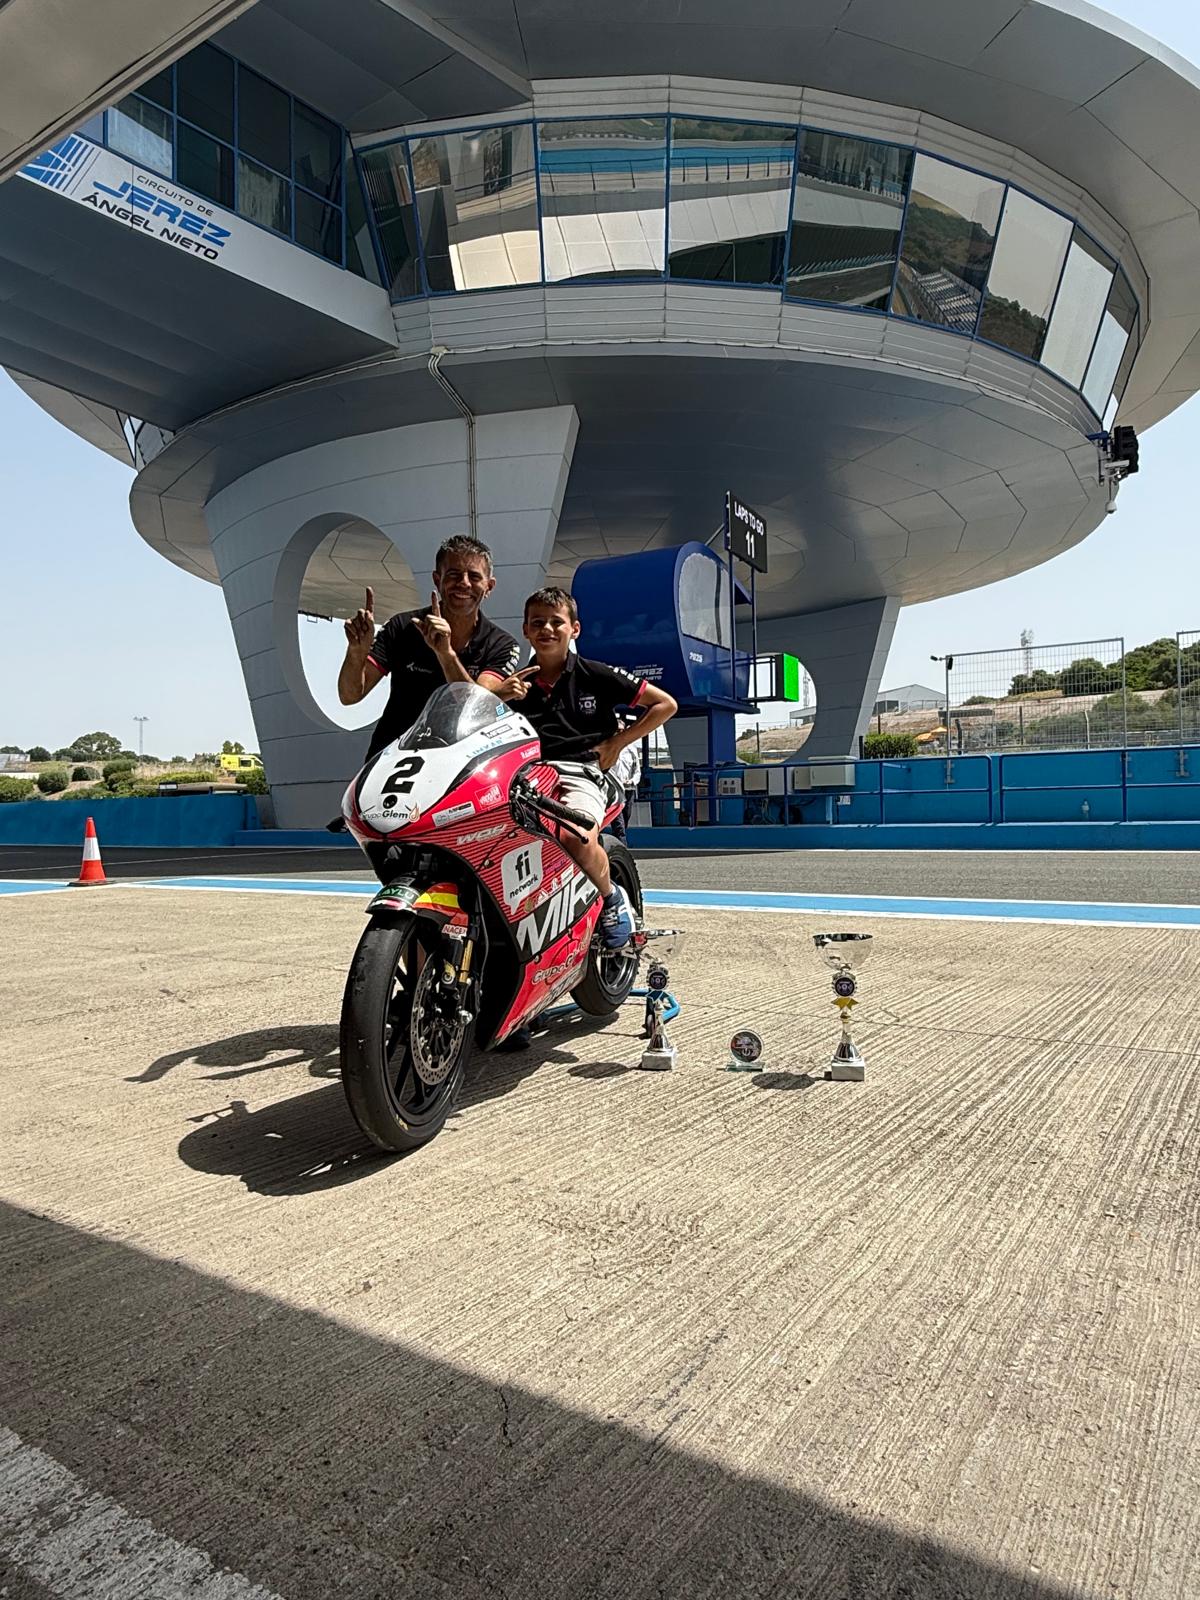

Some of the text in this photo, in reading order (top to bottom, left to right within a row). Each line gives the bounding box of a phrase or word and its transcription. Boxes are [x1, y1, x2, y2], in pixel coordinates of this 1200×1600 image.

[136, 174, 214, 217] CIRCUITO DE
[81, 191, 219, 261] ÁNGEL NIETO
[92, 180, 232, 248] JEREZ
[734, 501, 765, 536] LAPS TO GO
[745, 531, 755, 559] 11
[381, 756, 426, 794] 2
[382, 810, 409, 820] Glem
[515, 850, 531, 882] fi
[509, 874, 539, 899] network
